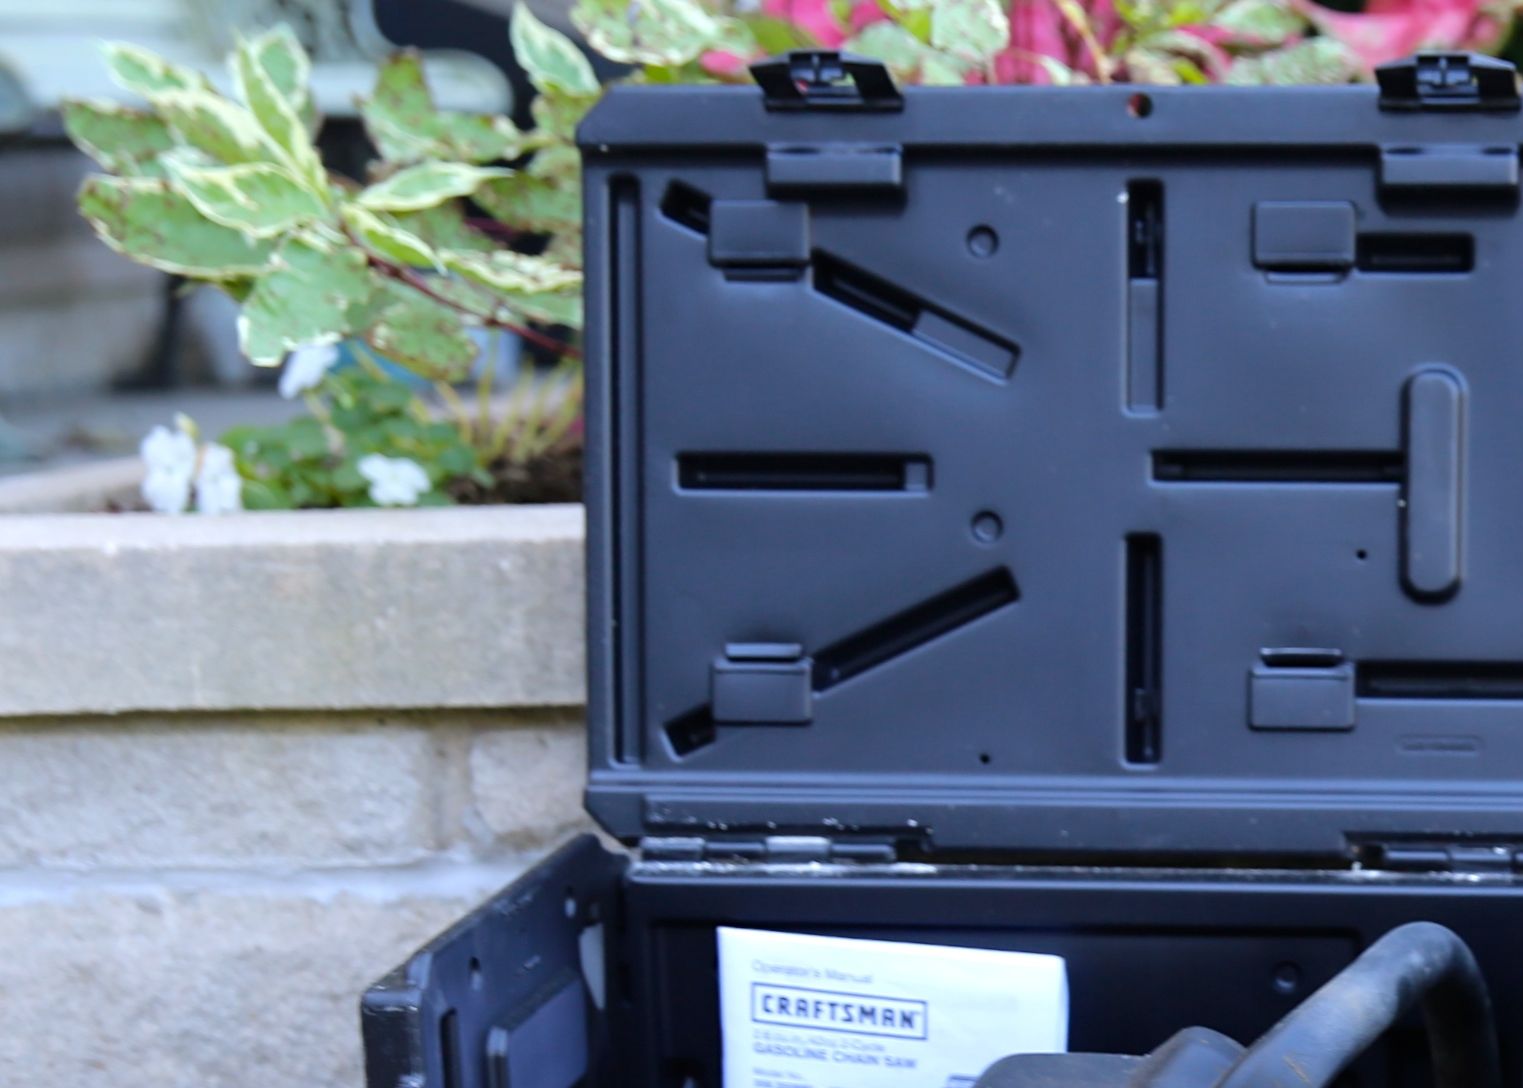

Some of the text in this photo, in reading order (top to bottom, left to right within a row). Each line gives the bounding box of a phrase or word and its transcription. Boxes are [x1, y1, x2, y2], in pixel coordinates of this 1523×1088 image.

[762, 994, 916, 1029] CRAFTSMAN
[752, 1041, 917, 1069] GASOLINE CHAIN SAW
